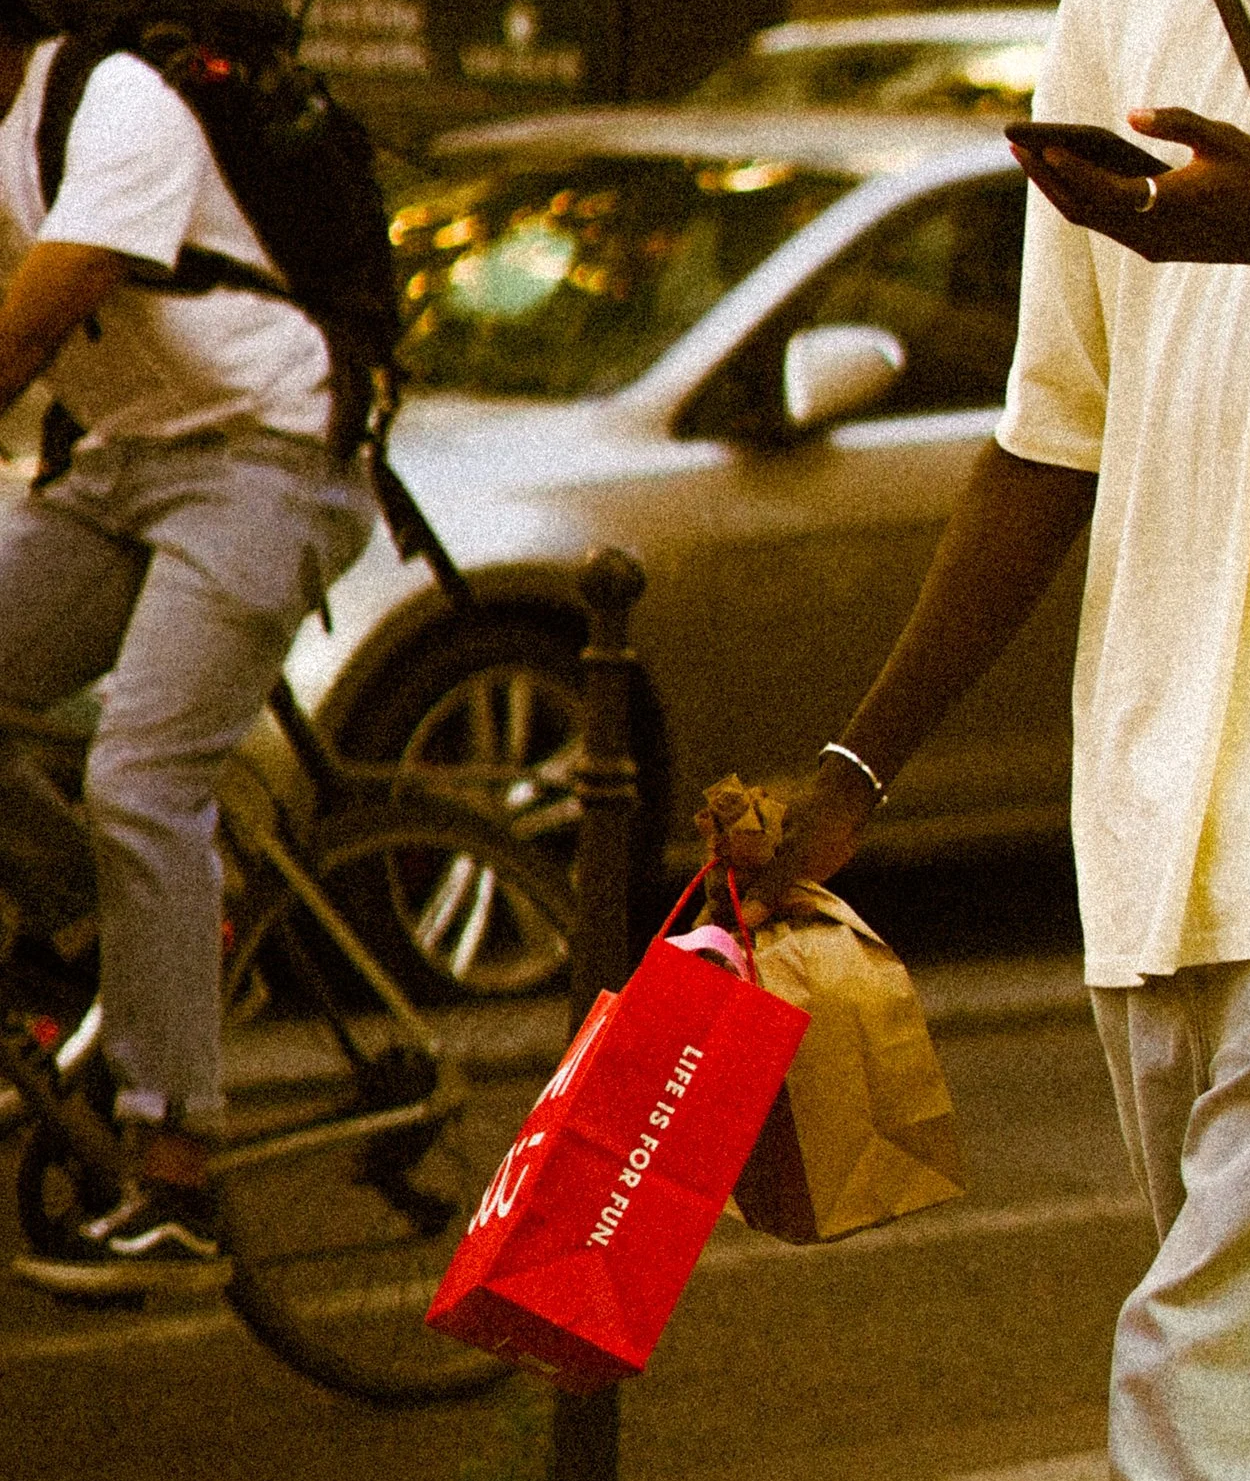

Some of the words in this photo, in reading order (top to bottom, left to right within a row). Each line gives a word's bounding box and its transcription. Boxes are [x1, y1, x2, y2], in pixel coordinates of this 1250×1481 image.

[664, 1044, 704, 1099] LIFE
[649, 1101, 676, 1130] IS
[617, 1132, 660, 1188] FOR
[585, 1190, 630, 1247] FUN.
